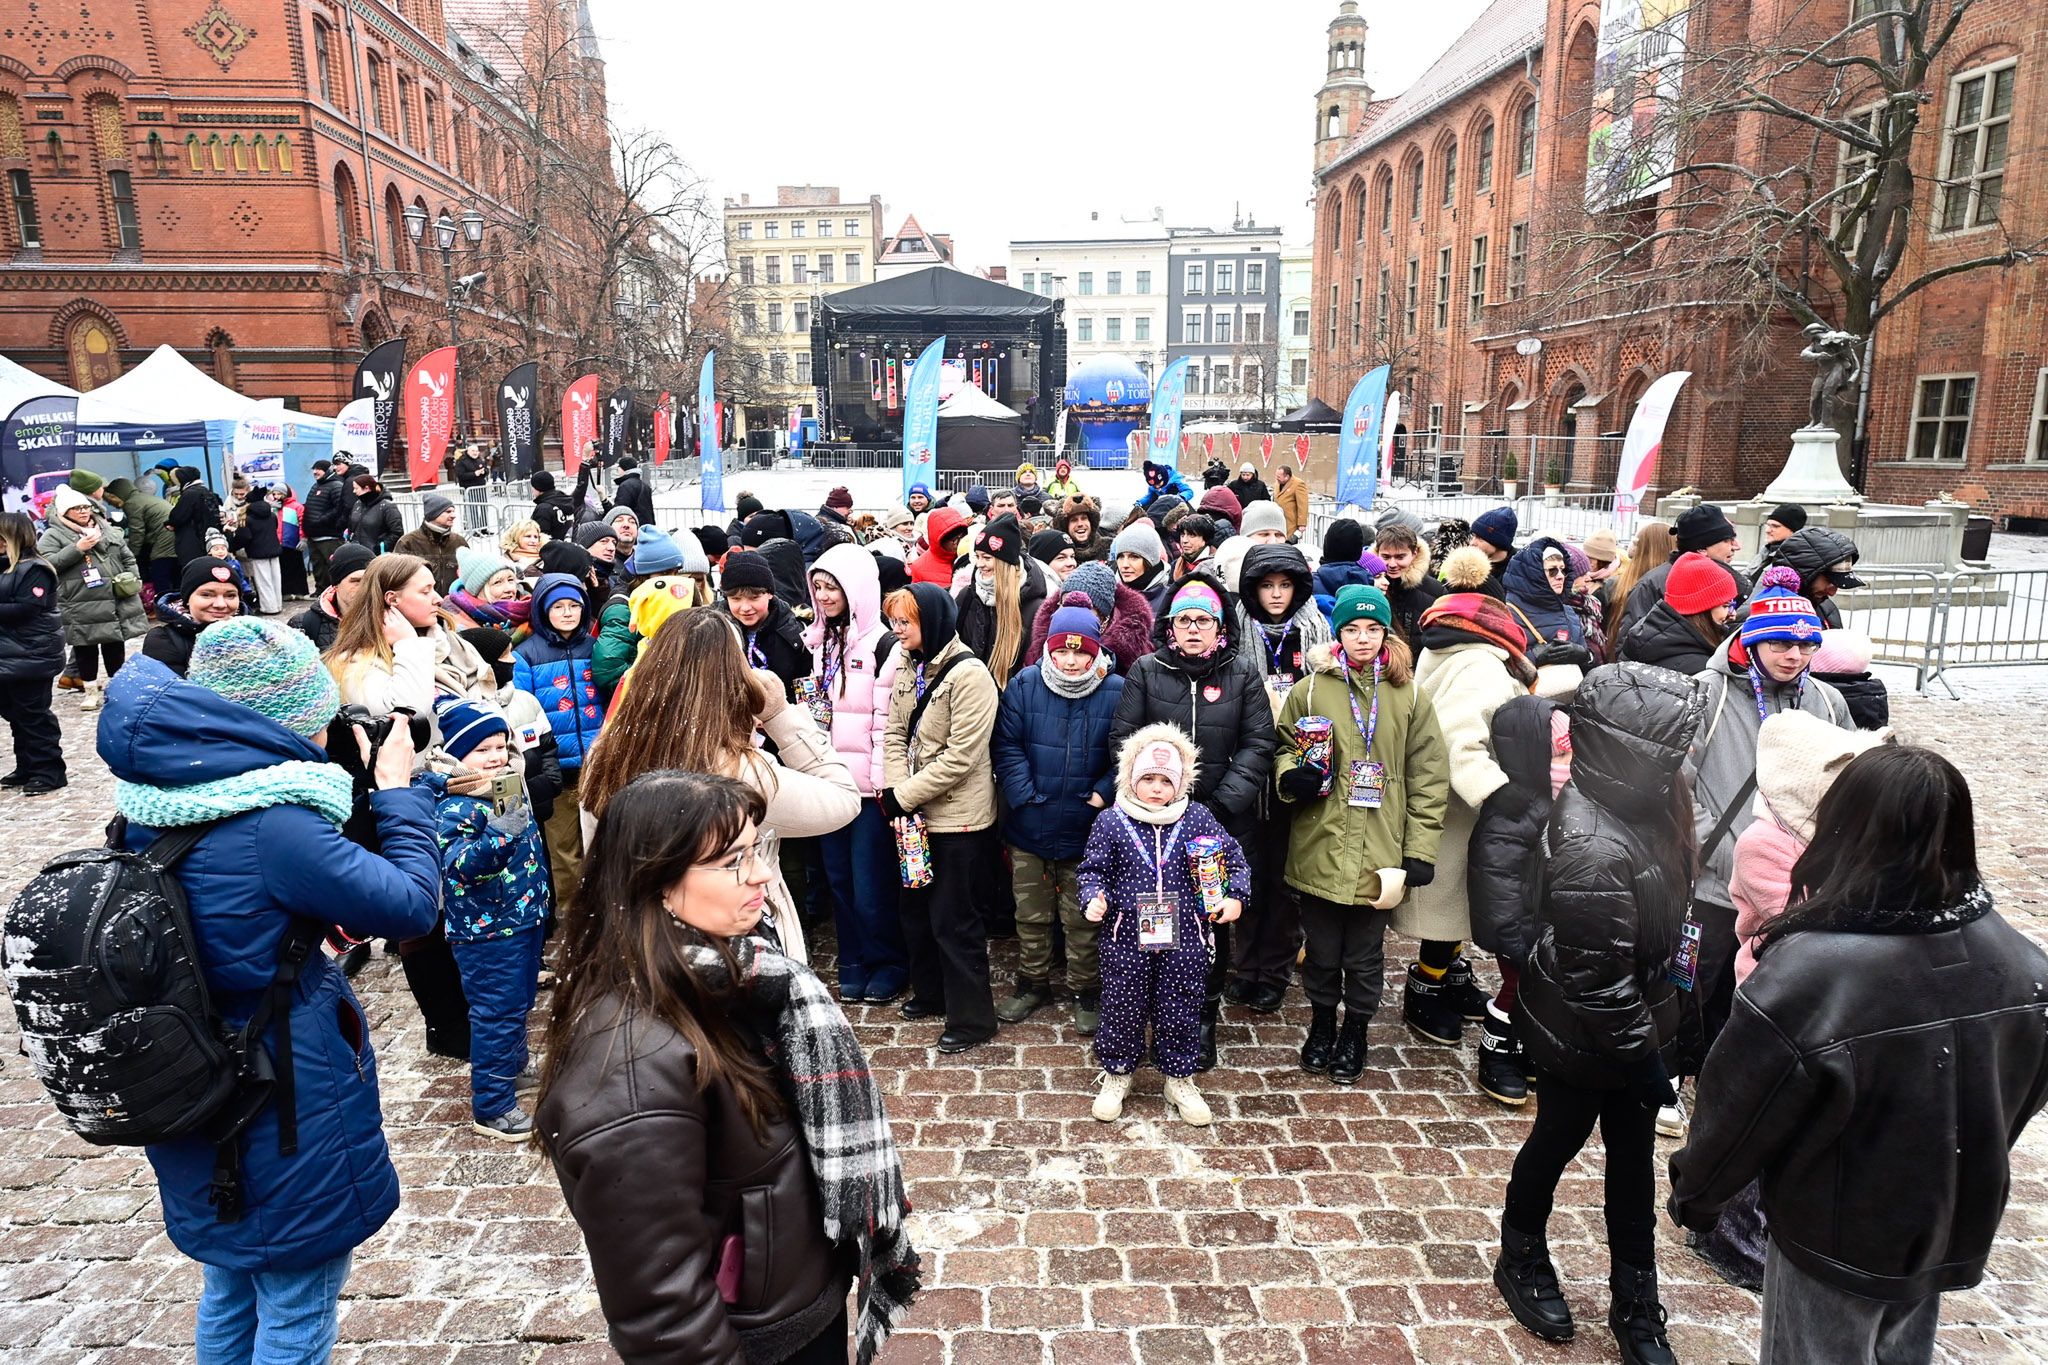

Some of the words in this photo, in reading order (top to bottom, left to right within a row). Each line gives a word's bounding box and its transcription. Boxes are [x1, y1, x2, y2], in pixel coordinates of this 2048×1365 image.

[21, 411, 76, 426] WIELKIE
[348, 422, 374, 430] MODEL
[430, 397, 440, 435] PROJEKT
[439, 397, 449, 442] KRAJOWY
[514, 407, 524, 440] PROJEKT
[522, 408, 531, 446] KRAJOWY
[14, 424, 63, 438] emocje
[251, 432, 280, 441] MANIA
[252, 424, 281, 434] MODEL
[347, 429, 374, 437] MANIA
[420, 396, 431, 463] ENERGETYCZNY
[506, 407, 519, 465] ENERGETYCZNY
